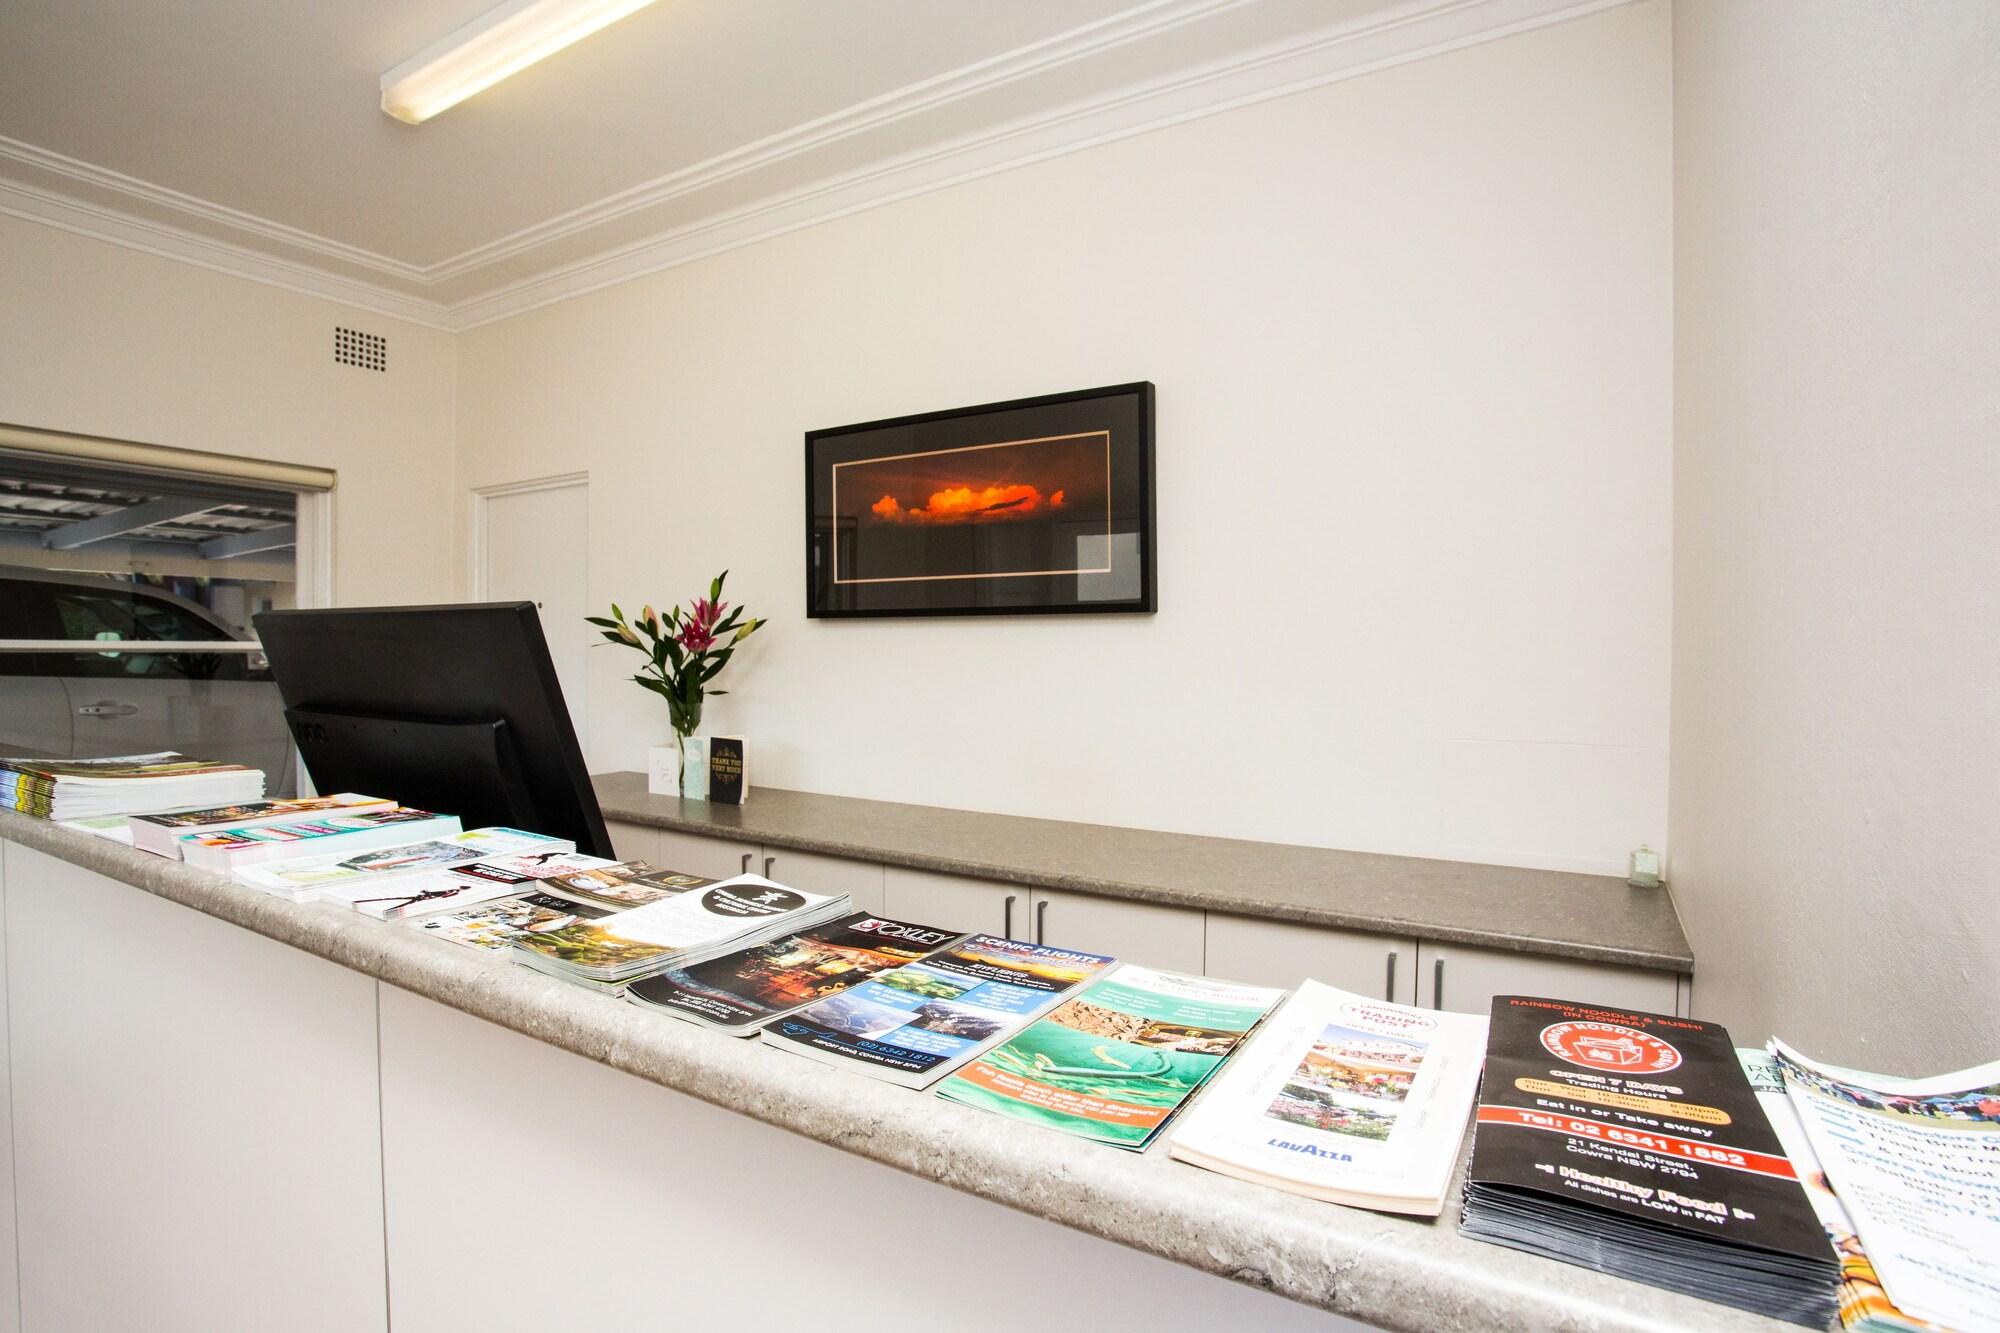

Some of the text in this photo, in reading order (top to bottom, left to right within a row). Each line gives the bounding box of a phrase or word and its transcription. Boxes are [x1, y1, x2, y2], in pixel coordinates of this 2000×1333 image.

[976, 936, 1101, 964] SCENIC FLIGHTS
[1349, 1006, 1430, 1026] TRADING
[1362, 1016, 1409, 1028] POST
[1510, 999, 1575, 1013] RAINBOW
[1579, 1007, 1639, 1021] NOODLE
[1657, 1019, 1703, 1031] SUSHI
[1563, 1011, 1646, 1028] (IN COWRA)
[857, 1040, 935, 1062] (02) 6342 1812
[1546, 1023, 1574, 1058] RAINBOW
[1574, 1023, 1650, 1041] NOODLE
[1650, 1048, 1675, 1069] SUSHI
[1549, 1070, 1684, 1095] OPEN 7 DAYS
[1566, 1079, 1668, 1100] Trading Hours
[1536, 1099, 1565, 1110] Eat
[1614, 1112, 1660, 1127] Take
[1663, 1123, 1713, 1137] away
[1518, 1112, 1747, 1167] Tel: 02 6341 1882
[1567, 1138, 1694, 1172] 21 Kendal Street,
[1566, 1144, 1700, 1180] Cowra NSW 2794
[1559, 1166, 1728, 1216] Healthy Food
[1564, 1179, 1726, 1224] All dishes are LOW in FAT
